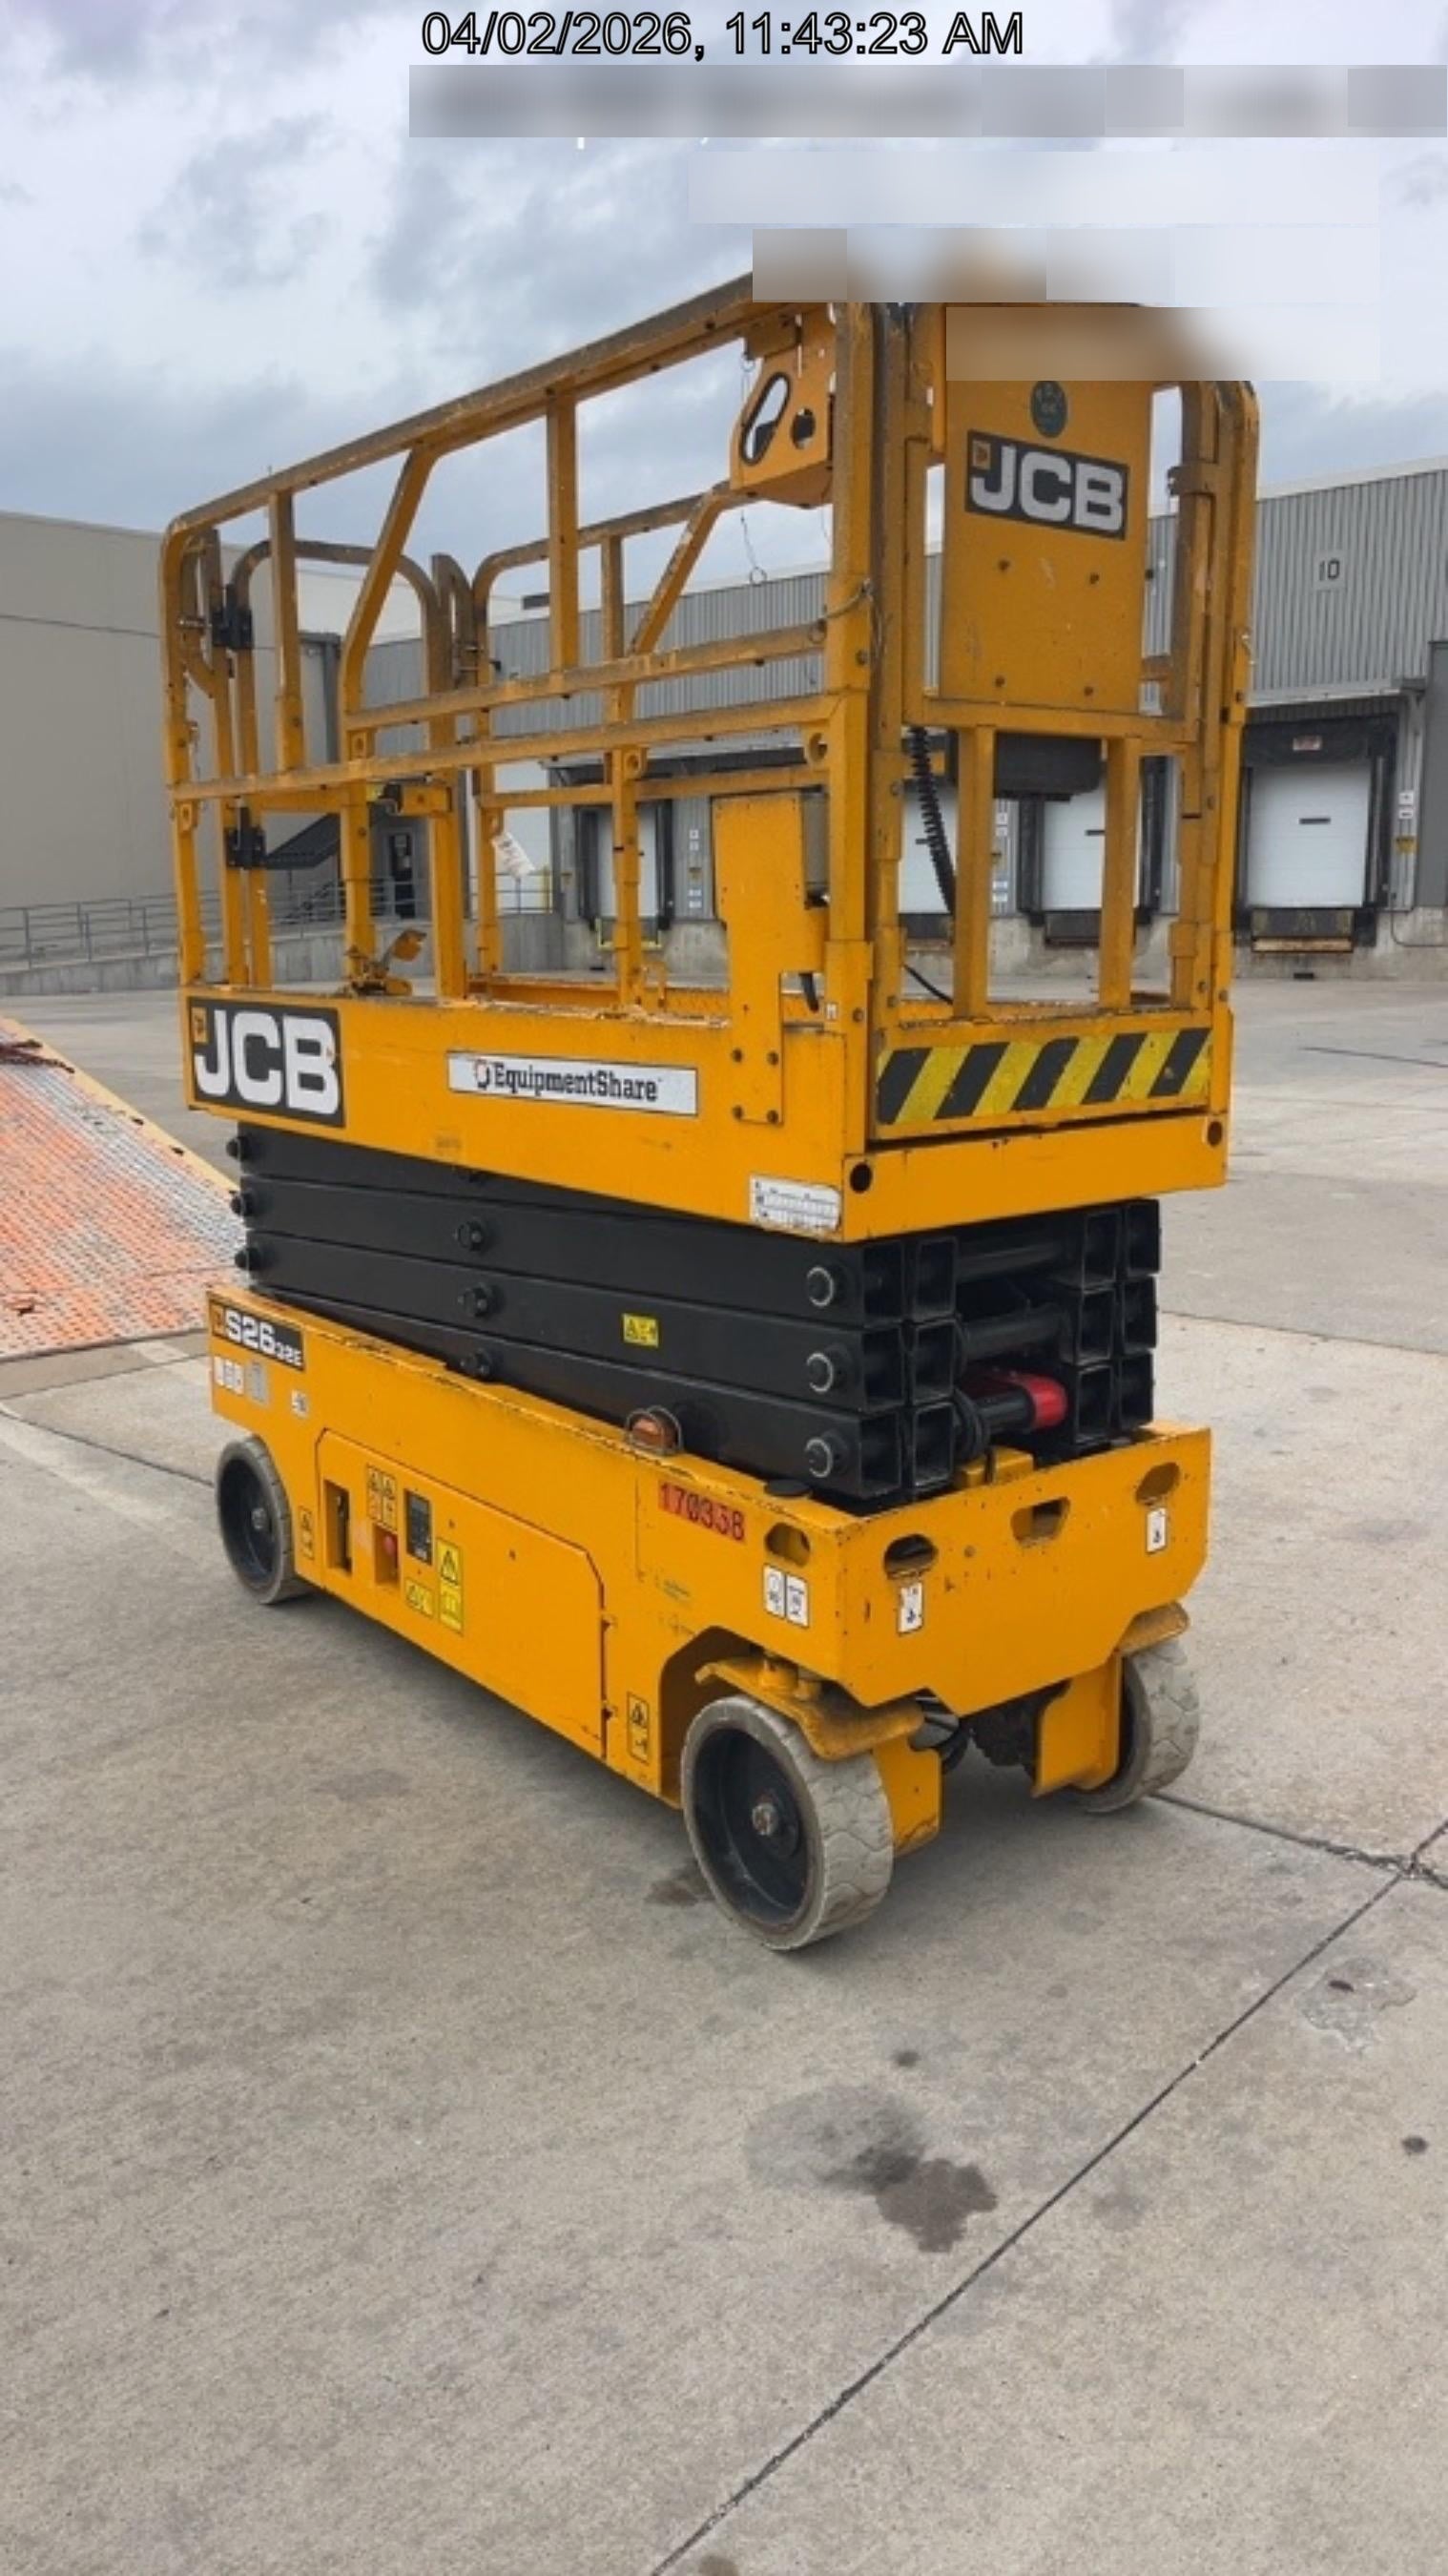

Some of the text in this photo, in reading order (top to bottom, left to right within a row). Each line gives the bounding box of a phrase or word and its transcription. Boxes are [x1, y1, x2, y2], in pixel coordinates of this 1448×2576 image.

[971, 443, 1124, 532] JCB
[195, 1008, 340, 1114] JCB
[494, 1063, 658, 1101] EquipmentShare
